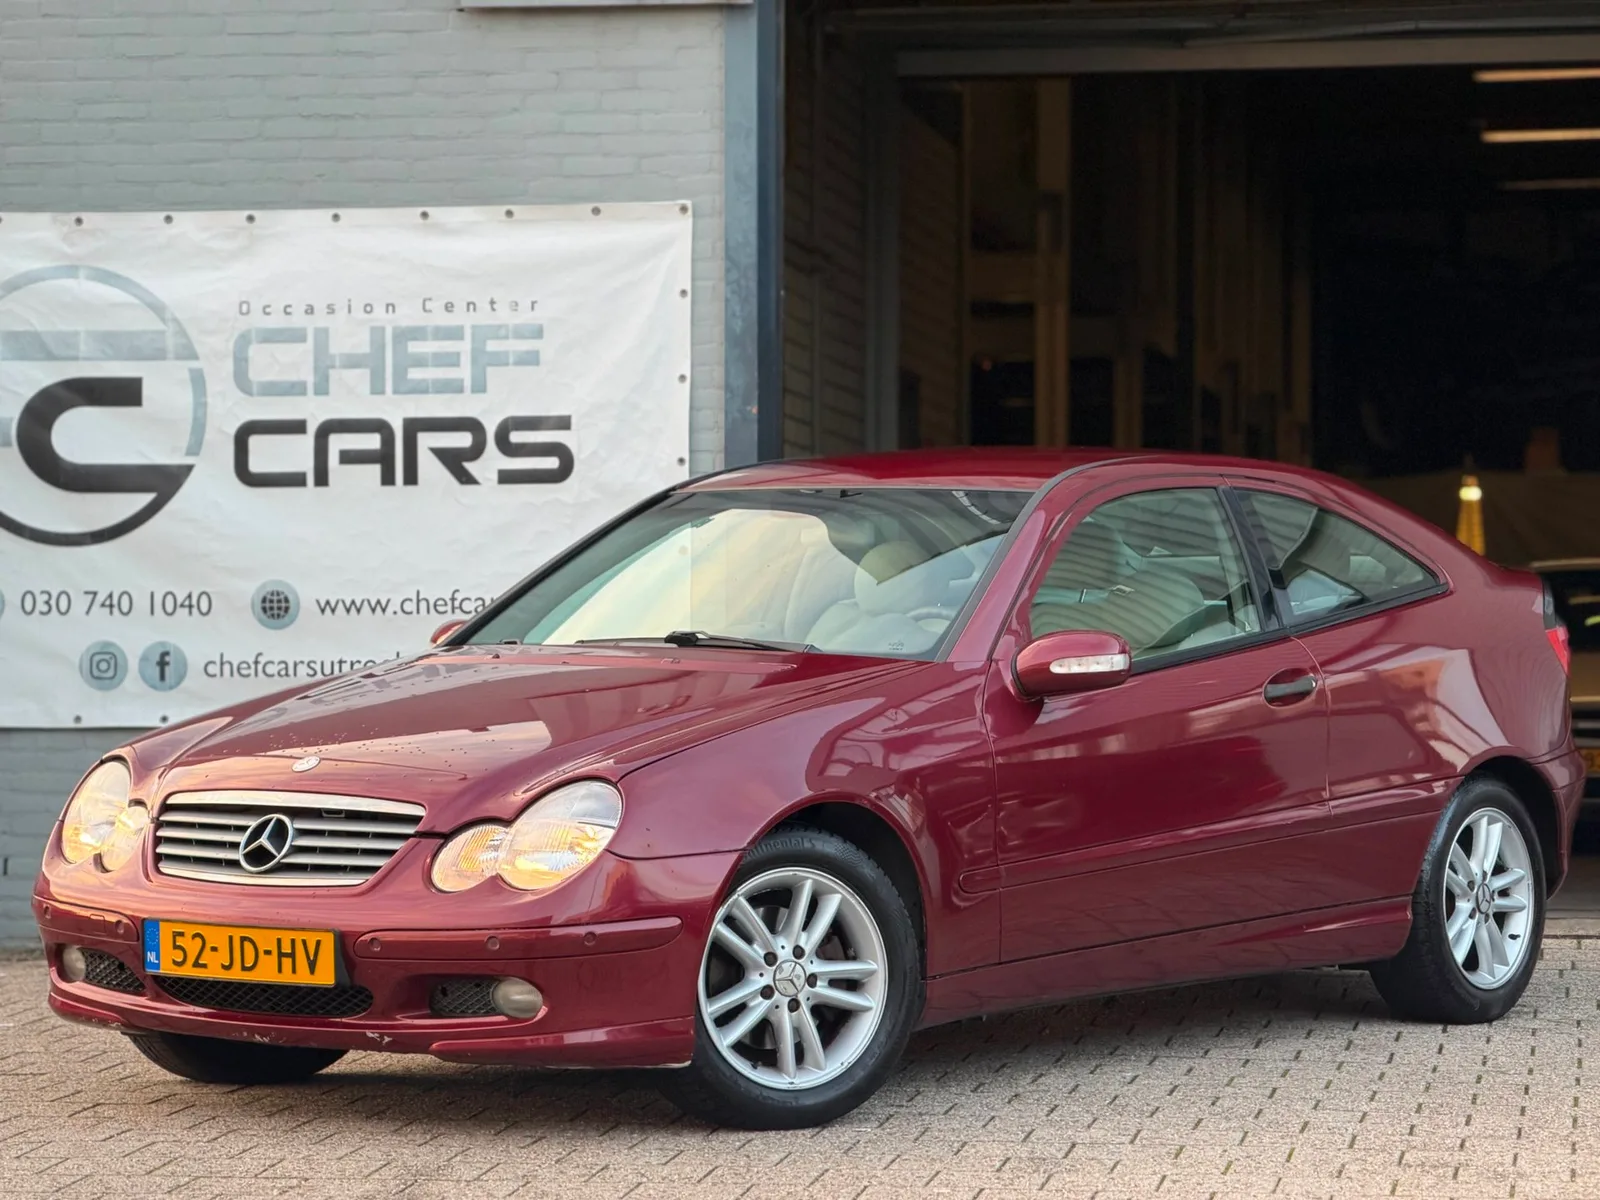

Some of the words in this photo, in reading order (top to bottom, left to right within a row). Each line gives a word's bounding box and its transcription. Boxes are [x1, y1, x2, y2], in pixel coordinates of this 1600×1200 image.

[237, 298, 397, 317] Occasion
[421, 297, 540, 315] Center
[232, 323, 544, 398] CHEF
[233, 414, 575, 489] CARS
[20, 589, 73, 617] 030
[83, 589, 134, 617] 740
[149, 590, 213, 617] 1040
[147, 951, 159, 964] NL
[171, 929, 322, 976] 52-JD-HV
